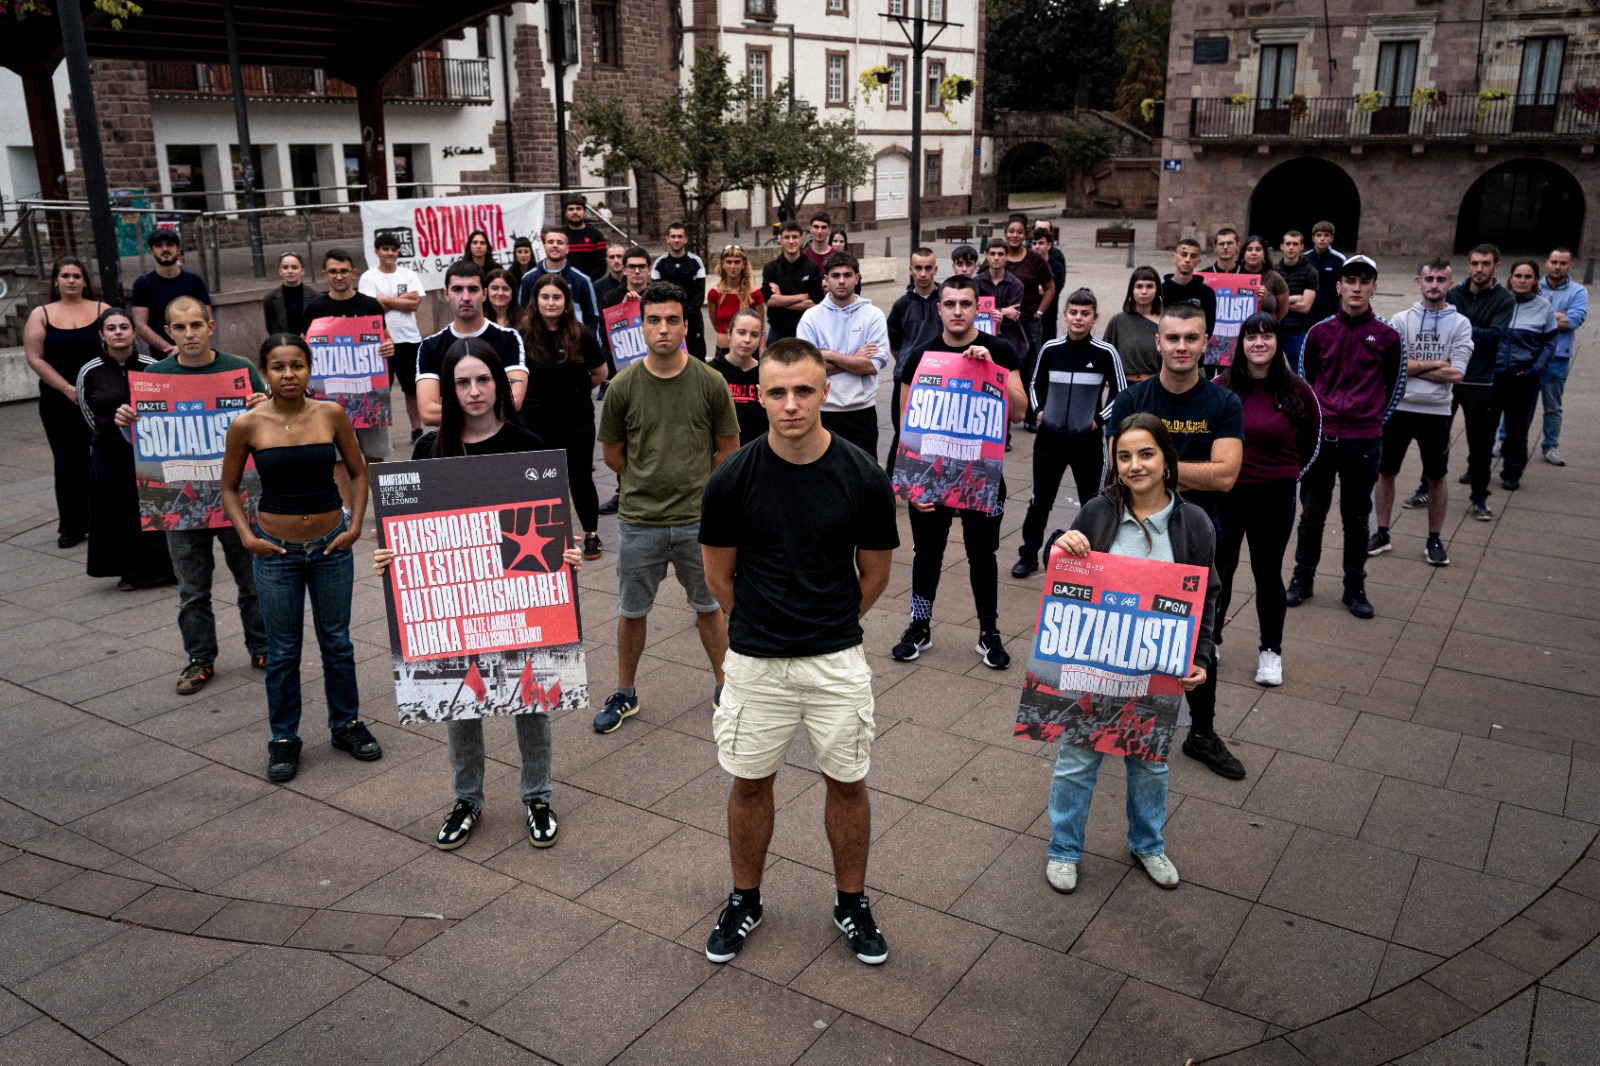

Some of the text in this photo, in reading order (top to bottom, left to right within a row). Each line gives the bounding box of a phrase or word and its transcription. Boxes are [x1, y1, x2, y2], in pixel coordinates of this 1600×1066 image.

[610, 319, 628, 330] GAZTE
[1415, 333, 1441, 342] NEW
[311, 343, 385, 376] SOZIALISTA
[1409, 343, 1445, 352] EARTH
[1409, 352, 1444, 360] SPIRIT
[918, 376, 941, 385] GAZTE
[137, 402, 167, 411] GAZTE
[219, 398, 244, 407] TPGN
[908, 388, 1004, 440] SOZIALISTA
[381, 496, 419, 507] ELIZONDO
[388, 510, 504, 556] FAXISMOAREN
[394, 545, 505, 590] ETA ESTATUEN
[400, 571, 571, 624] AUTORITARISMOAREN
[1053, 584, 1091, 600] GAZTE
[1158, 598, 1188, 615] TPGN
[405, 619, 463, 657] AURKA
[462, 616, 487, 635] GAZTE
[464, 629, 516, 651] SOZIALISMOA
[1039, 601, 1189, 677] SOZIALISTA
